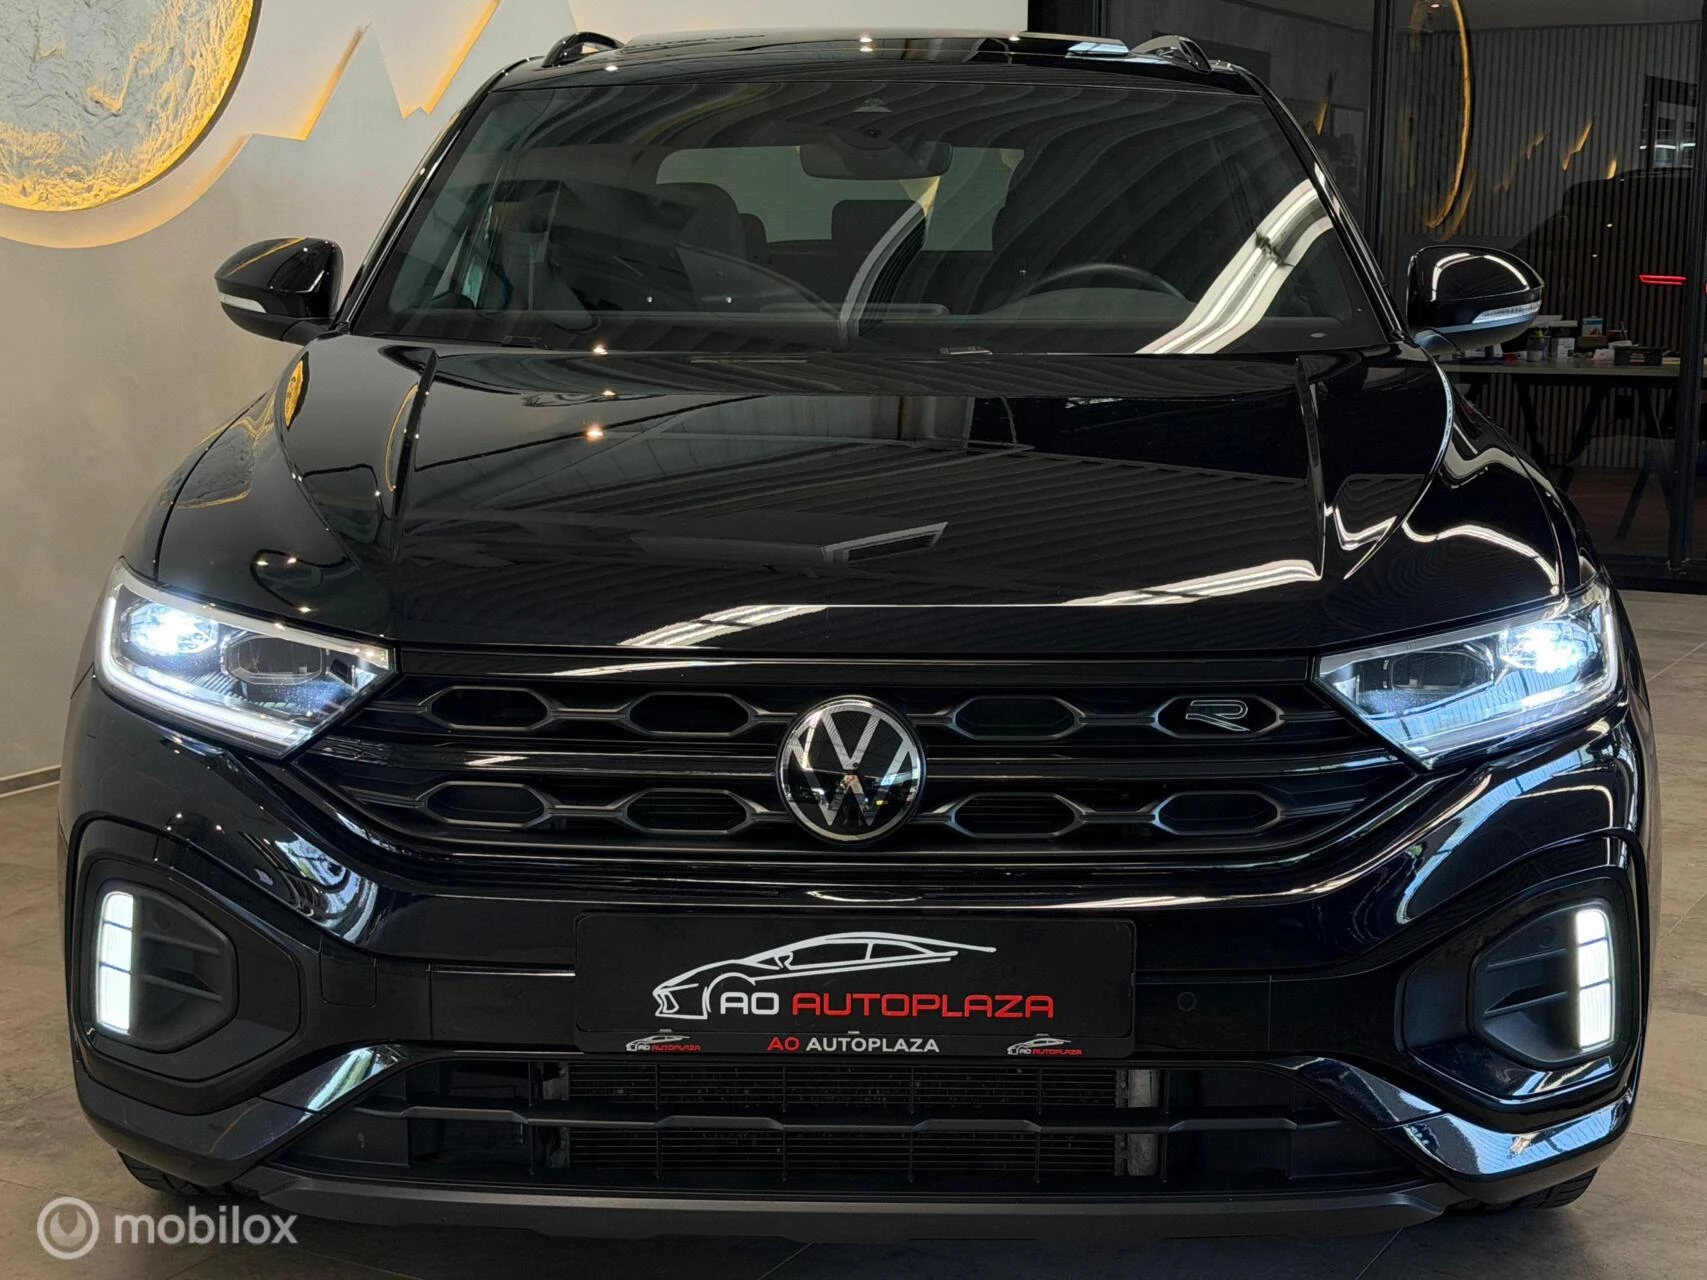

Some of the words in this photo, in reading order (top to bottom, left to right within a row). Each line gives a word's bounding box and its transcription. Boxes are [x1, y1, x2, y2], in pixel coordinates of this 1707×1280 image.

[720, 992, 779, 1014] AO
[792, 993, 1054, 1018] AUTOPLAZA
[767, 1038, 800, 1051] AO
[805, 1038, 940, 1053] AUTOPLAZA
